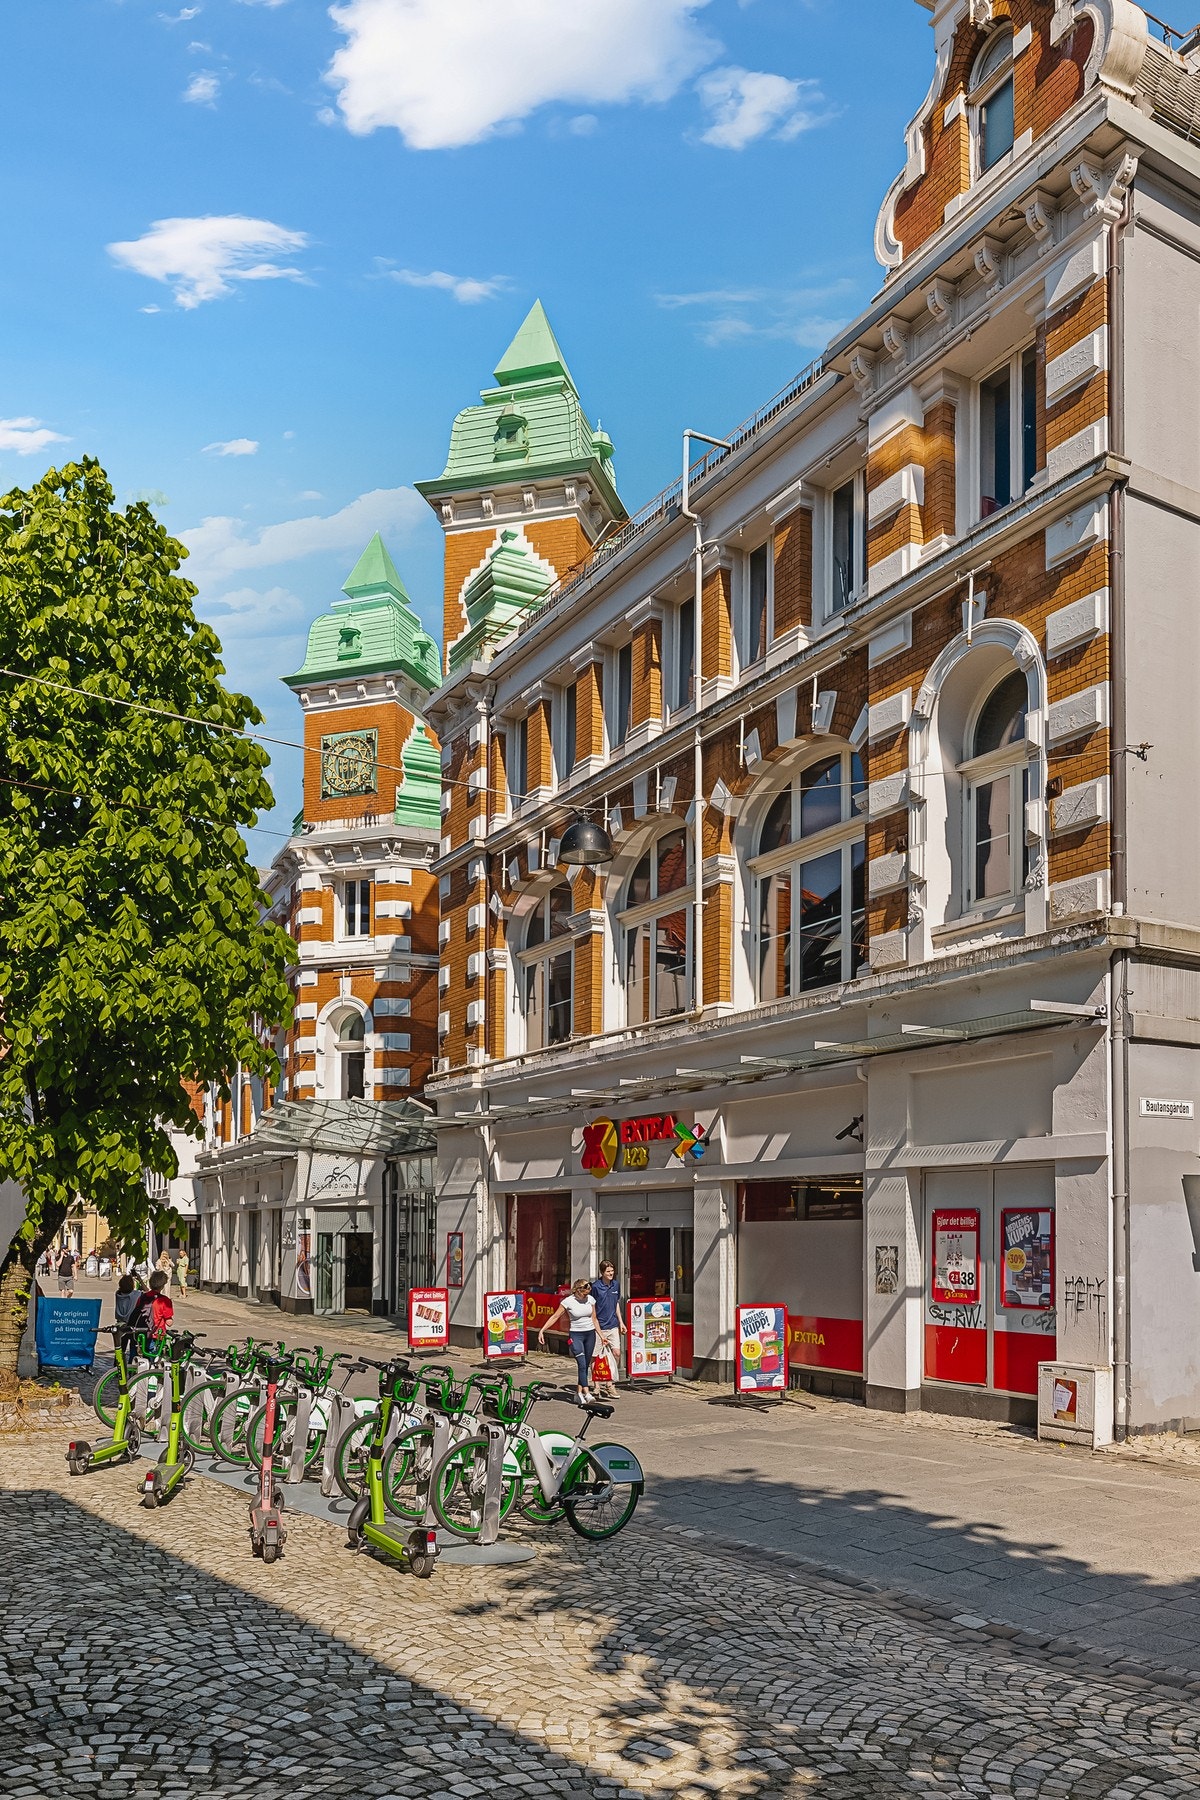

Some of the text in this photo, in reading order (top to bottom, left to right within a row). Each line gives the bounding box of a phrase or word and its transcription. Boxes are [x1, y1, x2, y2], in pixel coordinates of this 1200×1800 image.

[621, 1115, 677, 1143] EXTRA
[949, 1217, 959, 1226] det
[1007, 1222, 1035, 1246] KUPP!
[961, 1272, 974, 1285] 38
[490, 1300, 512, 1317] KUPP!
[537, 1305, 555, 1315] EXTRA
[491, 1321, 500, 1329] 75
[741, 1310, 767, 1327] MEDLEMS-
[431, 1324, 444, 1334] 119
[743, 1316, 770, 1338] KUPP!
[794, 1331, 825, 1345] EXTRA
[745, 1343, 755, 1353] 75
